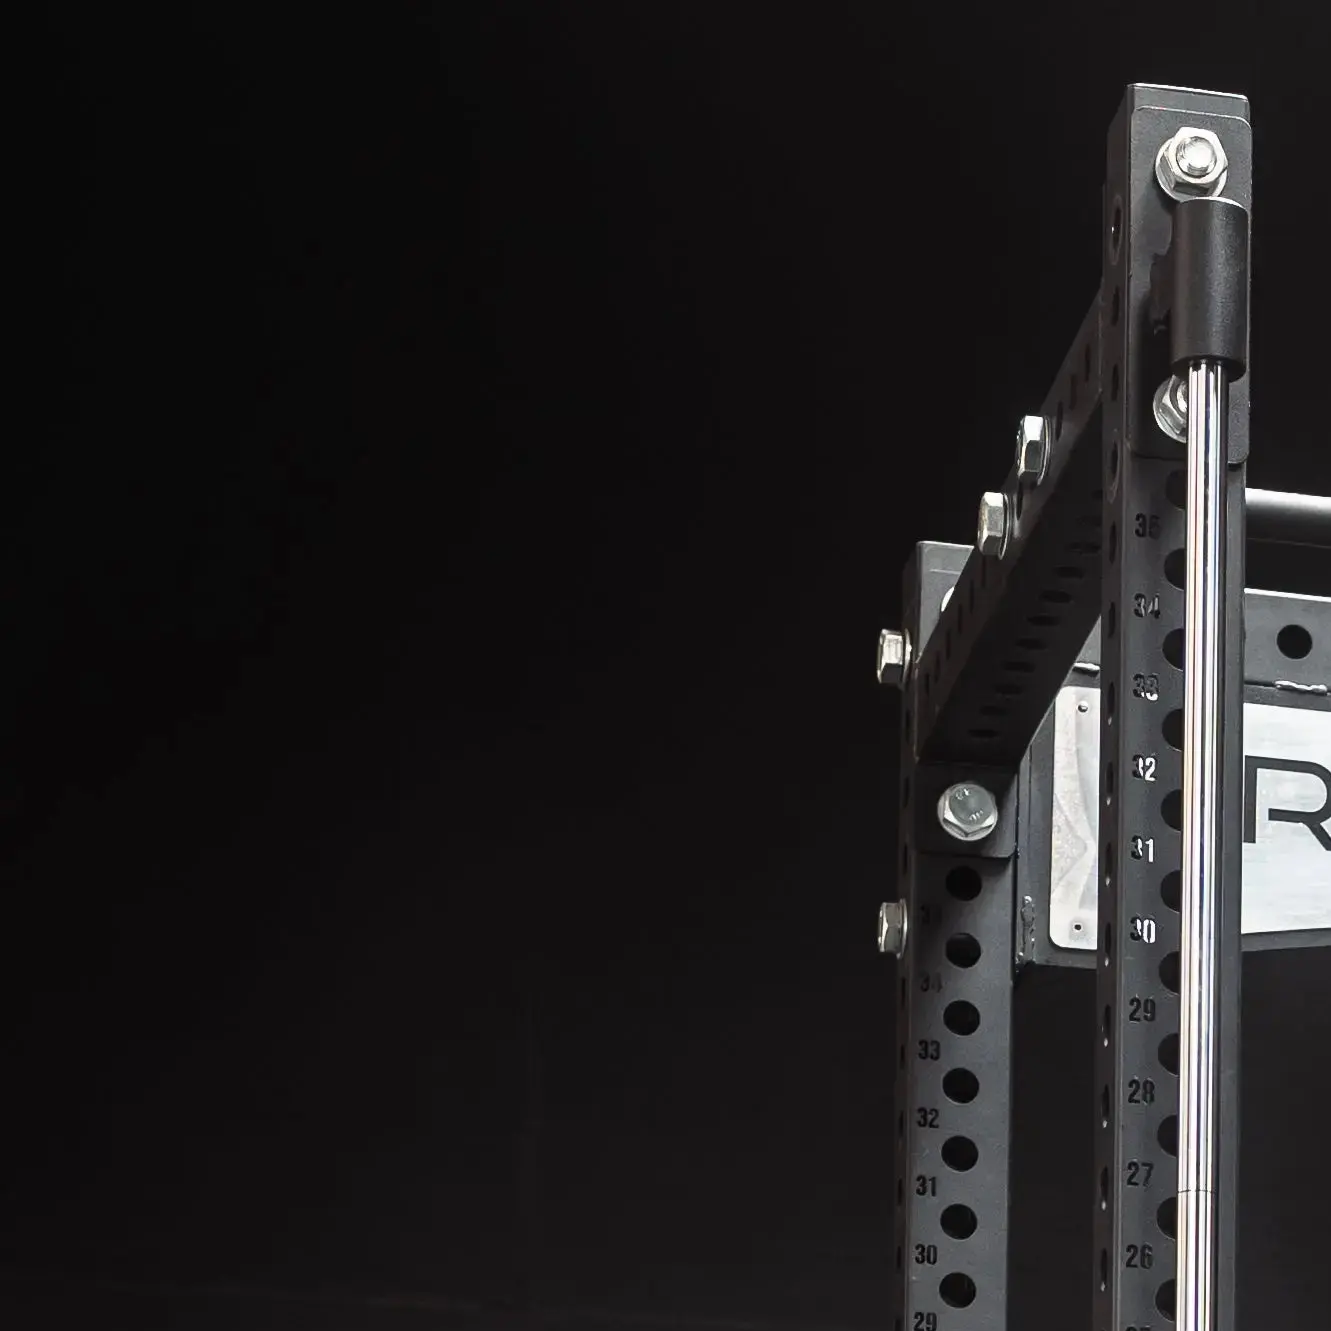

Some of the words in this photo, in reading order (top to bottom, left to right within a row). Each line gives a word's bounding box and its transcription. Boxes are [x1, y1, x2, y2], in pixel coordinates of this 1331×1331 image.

[1133, 592, 1161, 620] 34
[1131, 753, 1159, 781] 32
[1130, 834, 1156, 862] 31
[1129, 916, 1159, 945] 30
[1128, 996, 1157, 1023] 29
[917, 1038, 941, 1061] 33
[1127, 1078, 1156, 1105] 28
[915, 1106, 940, 1129] 32
[915, 1174, 937, 1197] 31
[1126, 1161, 1154, 1188] 27
[914, 1243, 938, 1266] 30
[1125, 1243, 1154, 1270] 26
